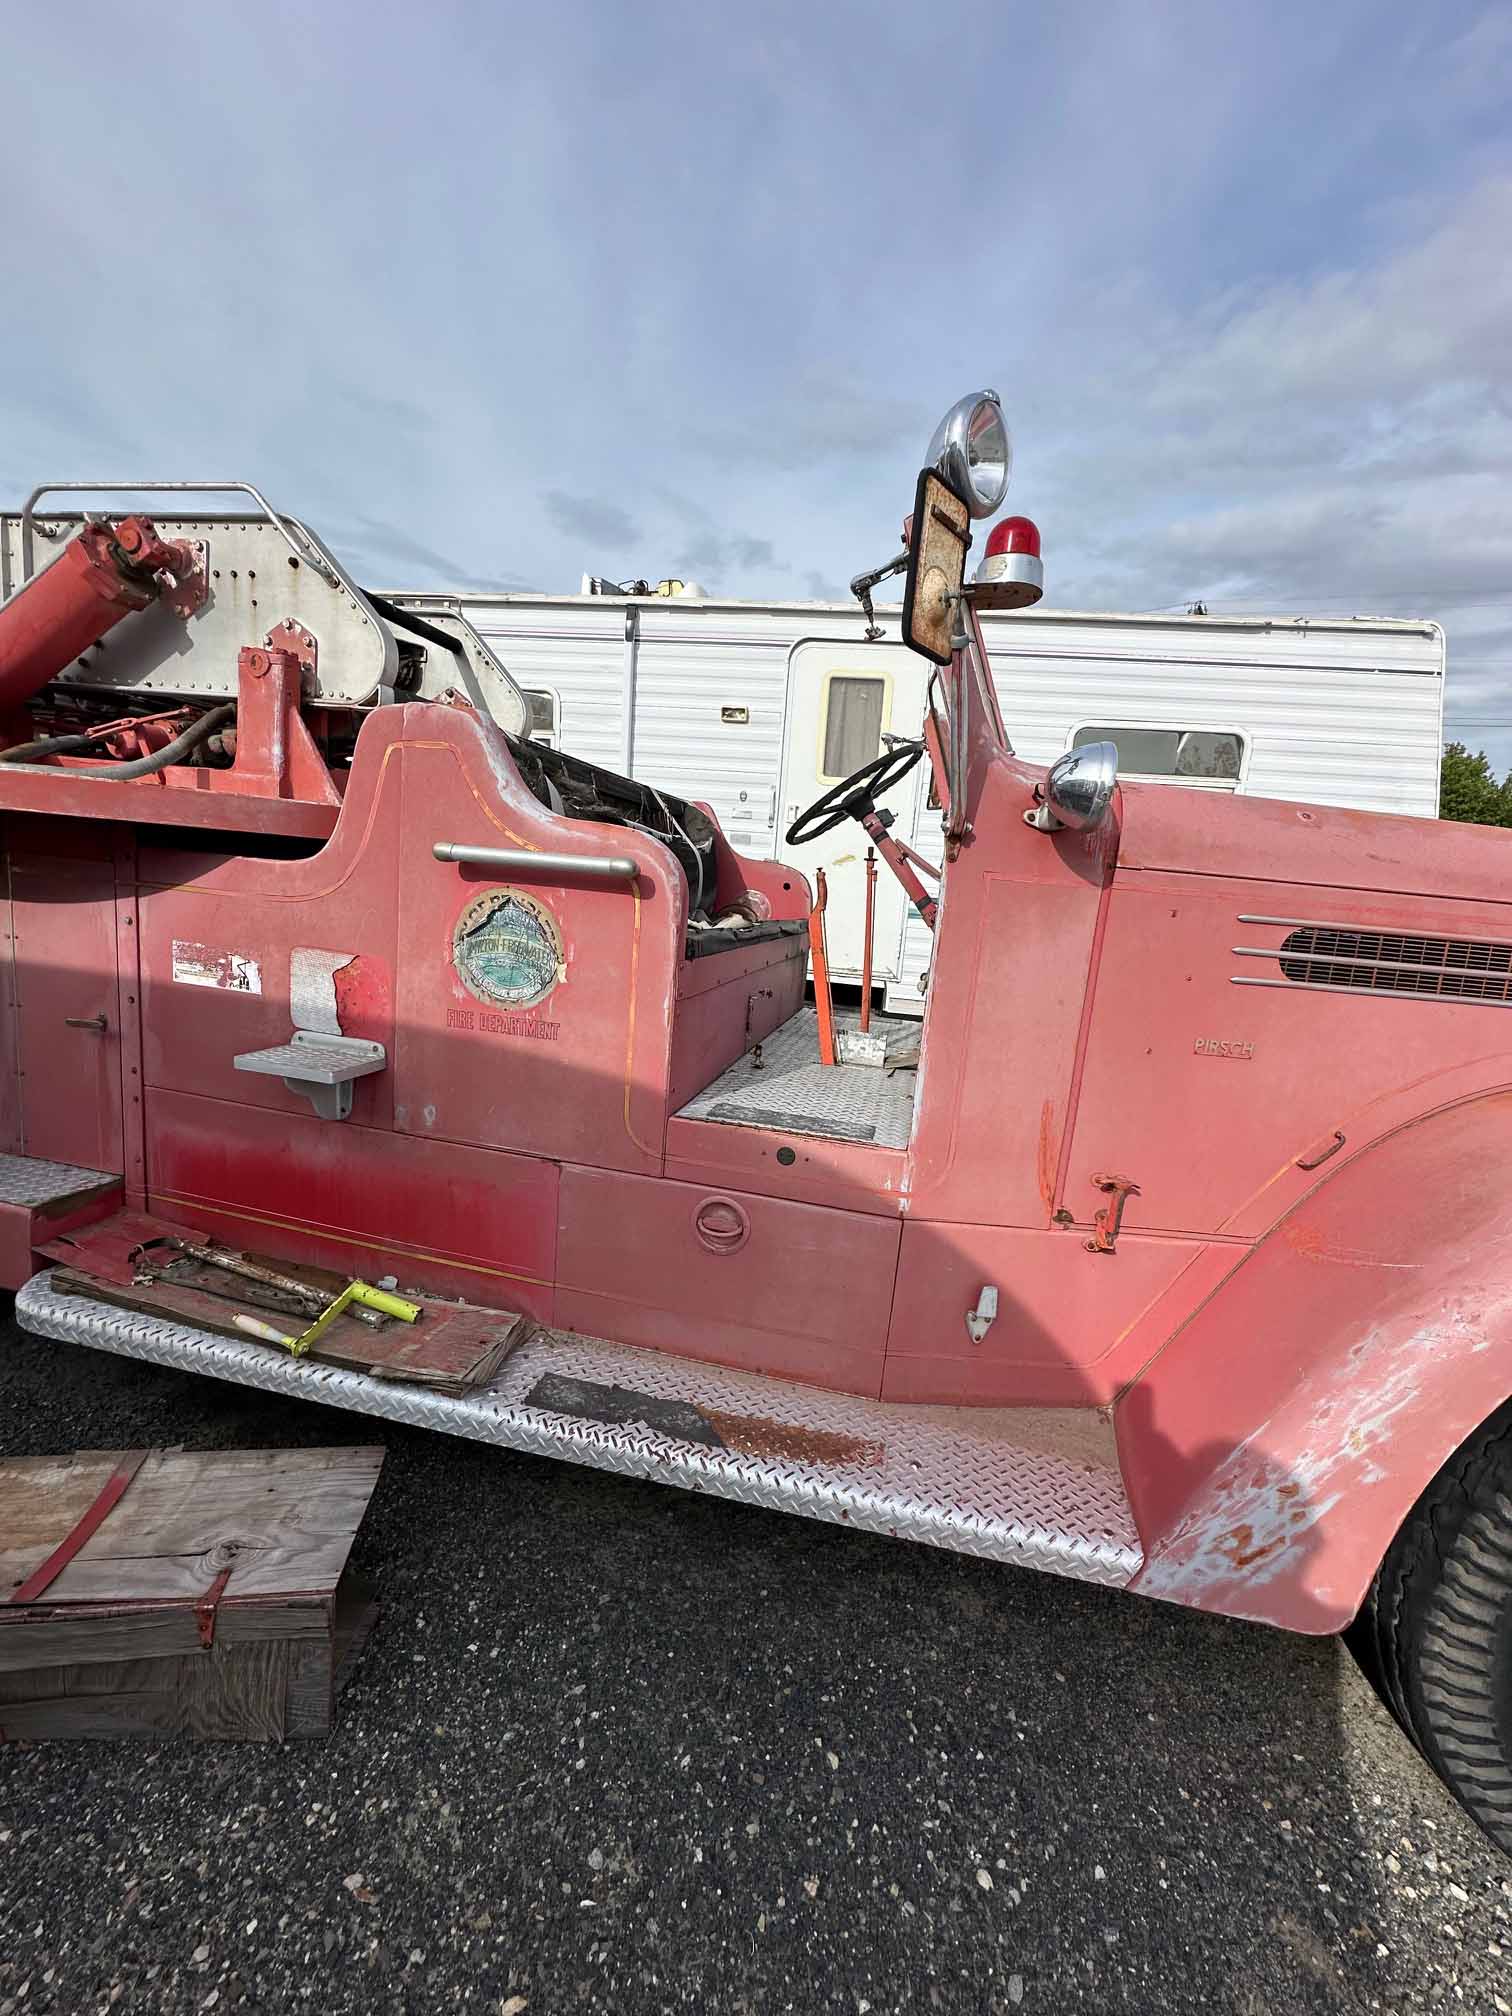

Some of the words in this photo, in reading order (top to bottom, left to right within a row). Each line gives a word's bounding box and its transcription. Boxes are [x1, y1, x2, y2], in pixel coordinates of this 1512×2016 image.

[447, 1009, 474, 1030] FIRE
[479, 1013, 560, 1040] DEPARTMENT
[1194, 1038, 1254, 1057] PIRSCH
